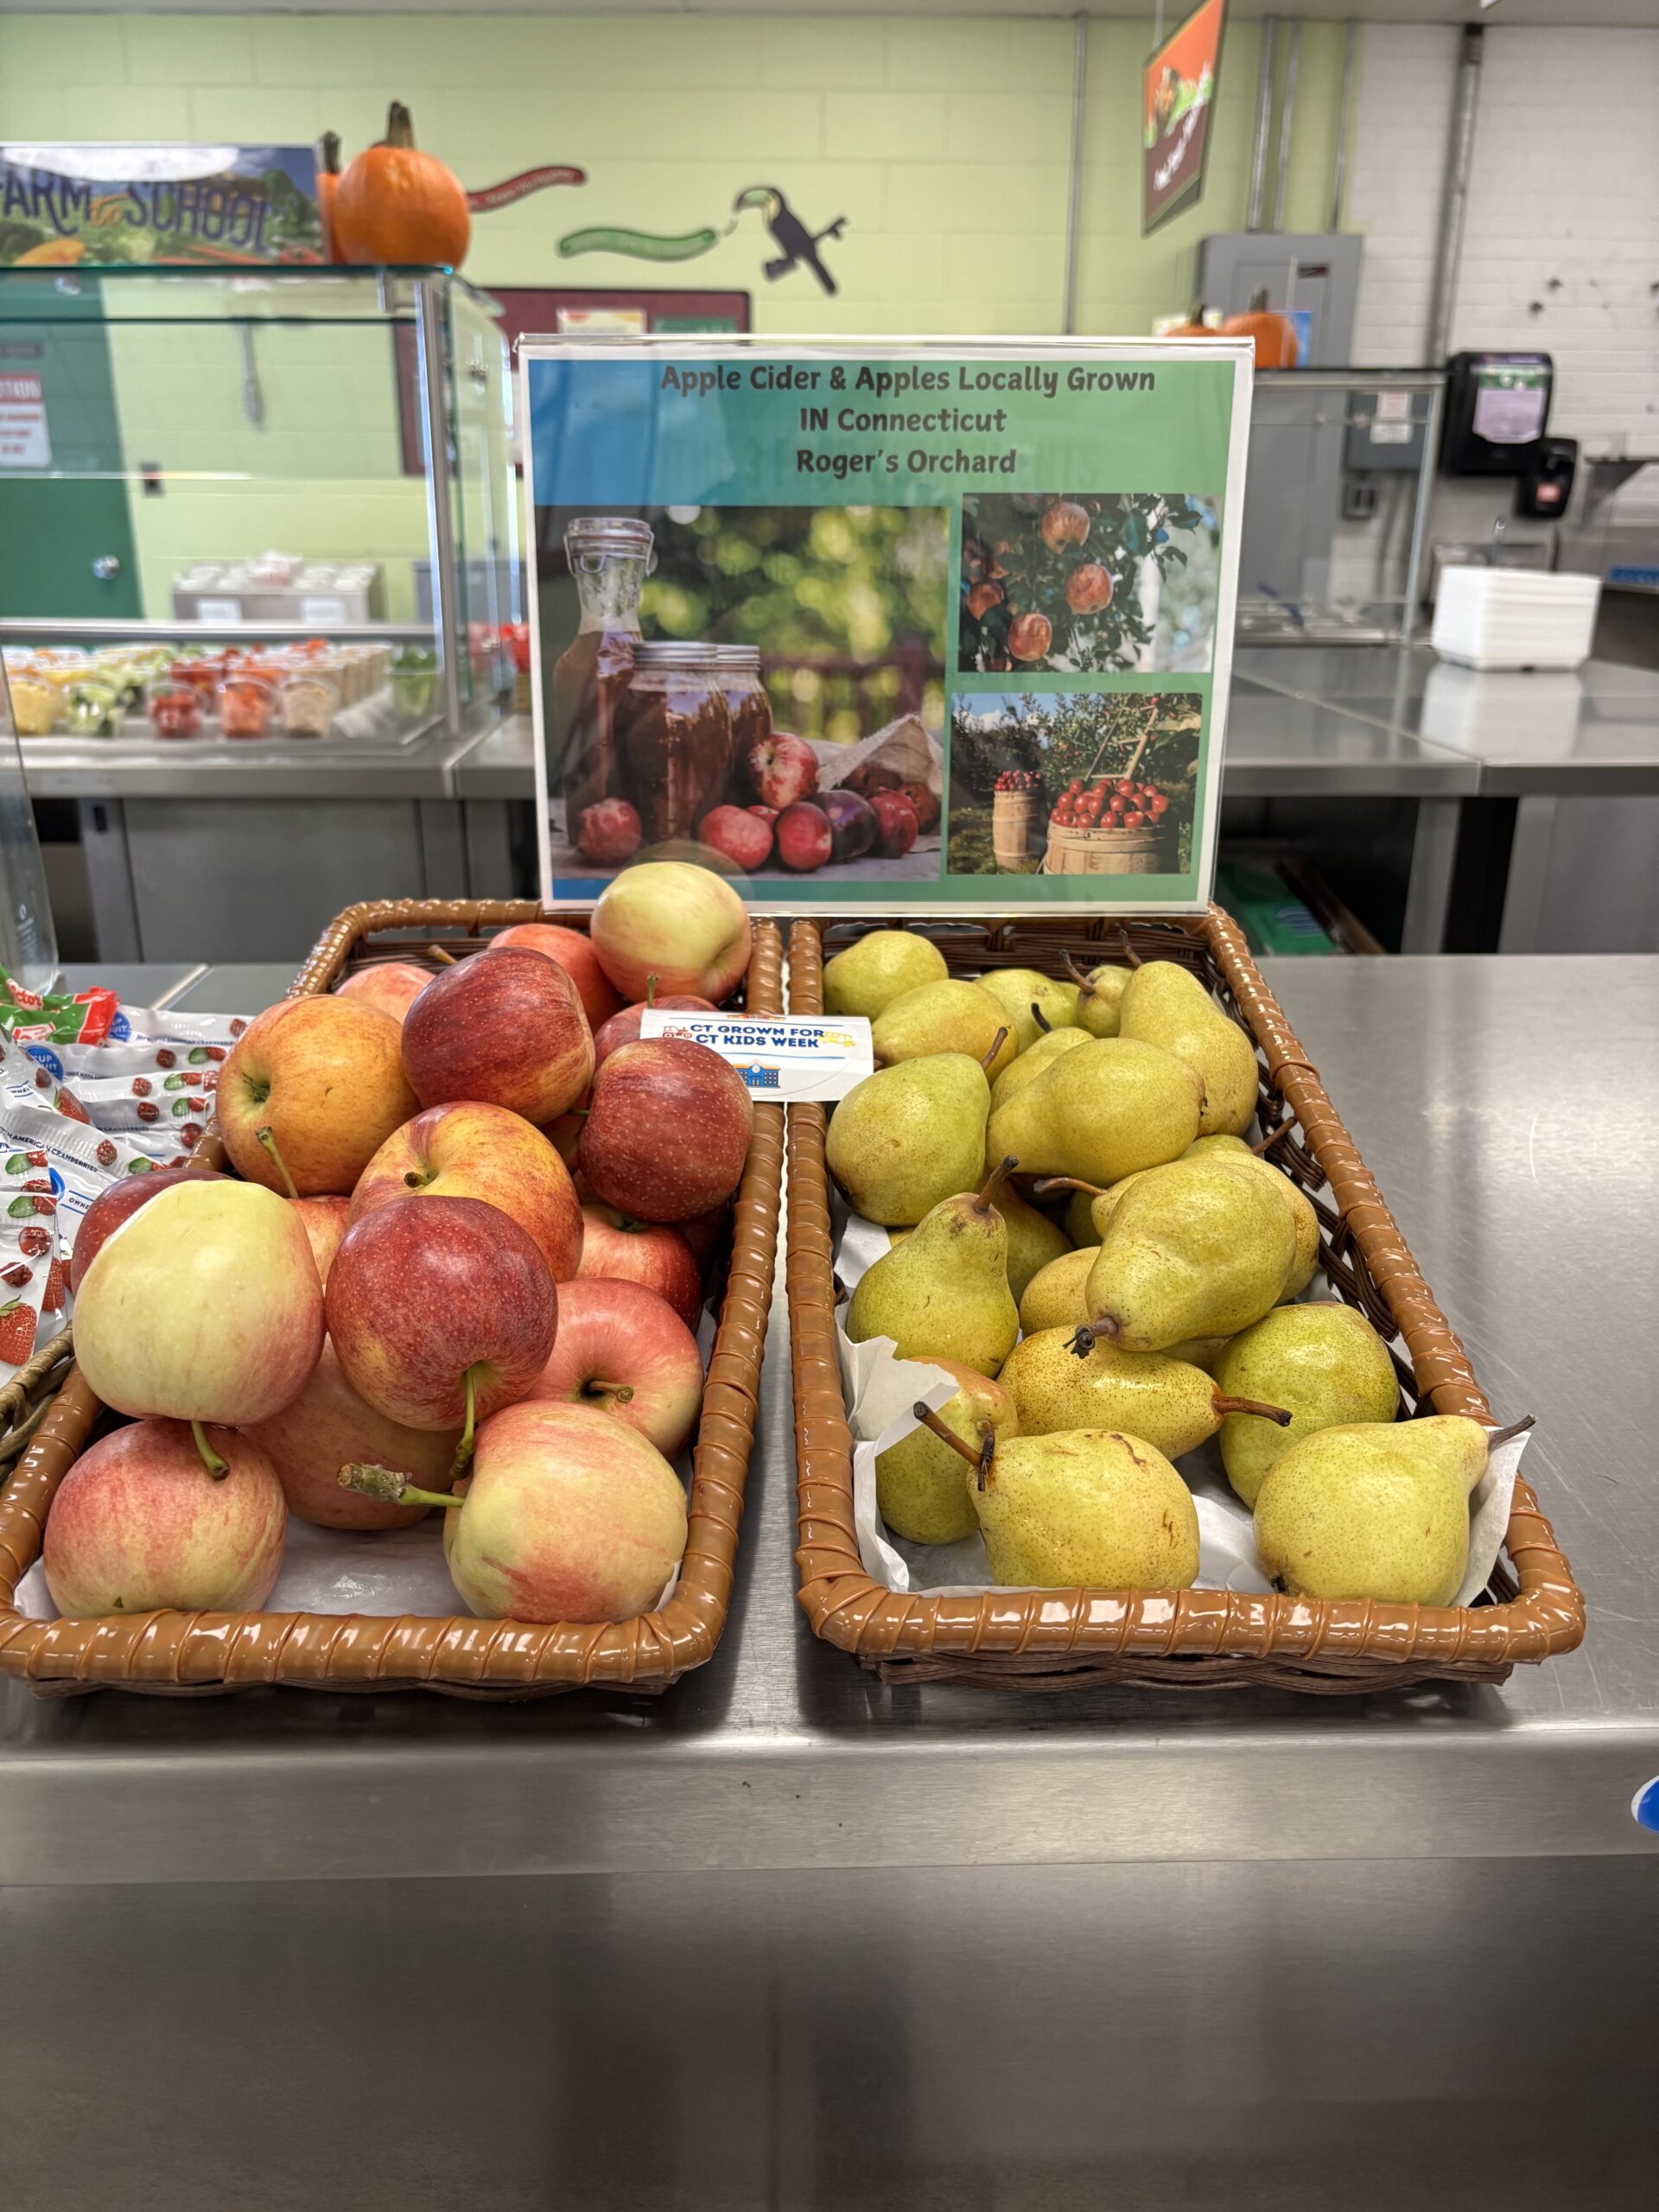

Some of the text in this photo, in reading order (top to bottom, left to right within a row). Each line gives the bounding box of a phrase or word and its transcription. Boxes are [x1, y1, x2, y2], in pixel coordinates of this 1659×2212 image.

[0, 159, 91, 236] ARM
[124, 175, 267, 251] SCHOOL
[660, 364, 1155, 399] Apple Cider & Apples Locally Grown
[800, 407, 1007, 432] IN Connecticut
[797, 448, 899, 480] Roger's
[907, 448, 1017, 474] Orchard
[690, 1024, 824, 1038] CT GROWN FOR
[696, 1033, 819, 1048] CT KIDS WEEK
